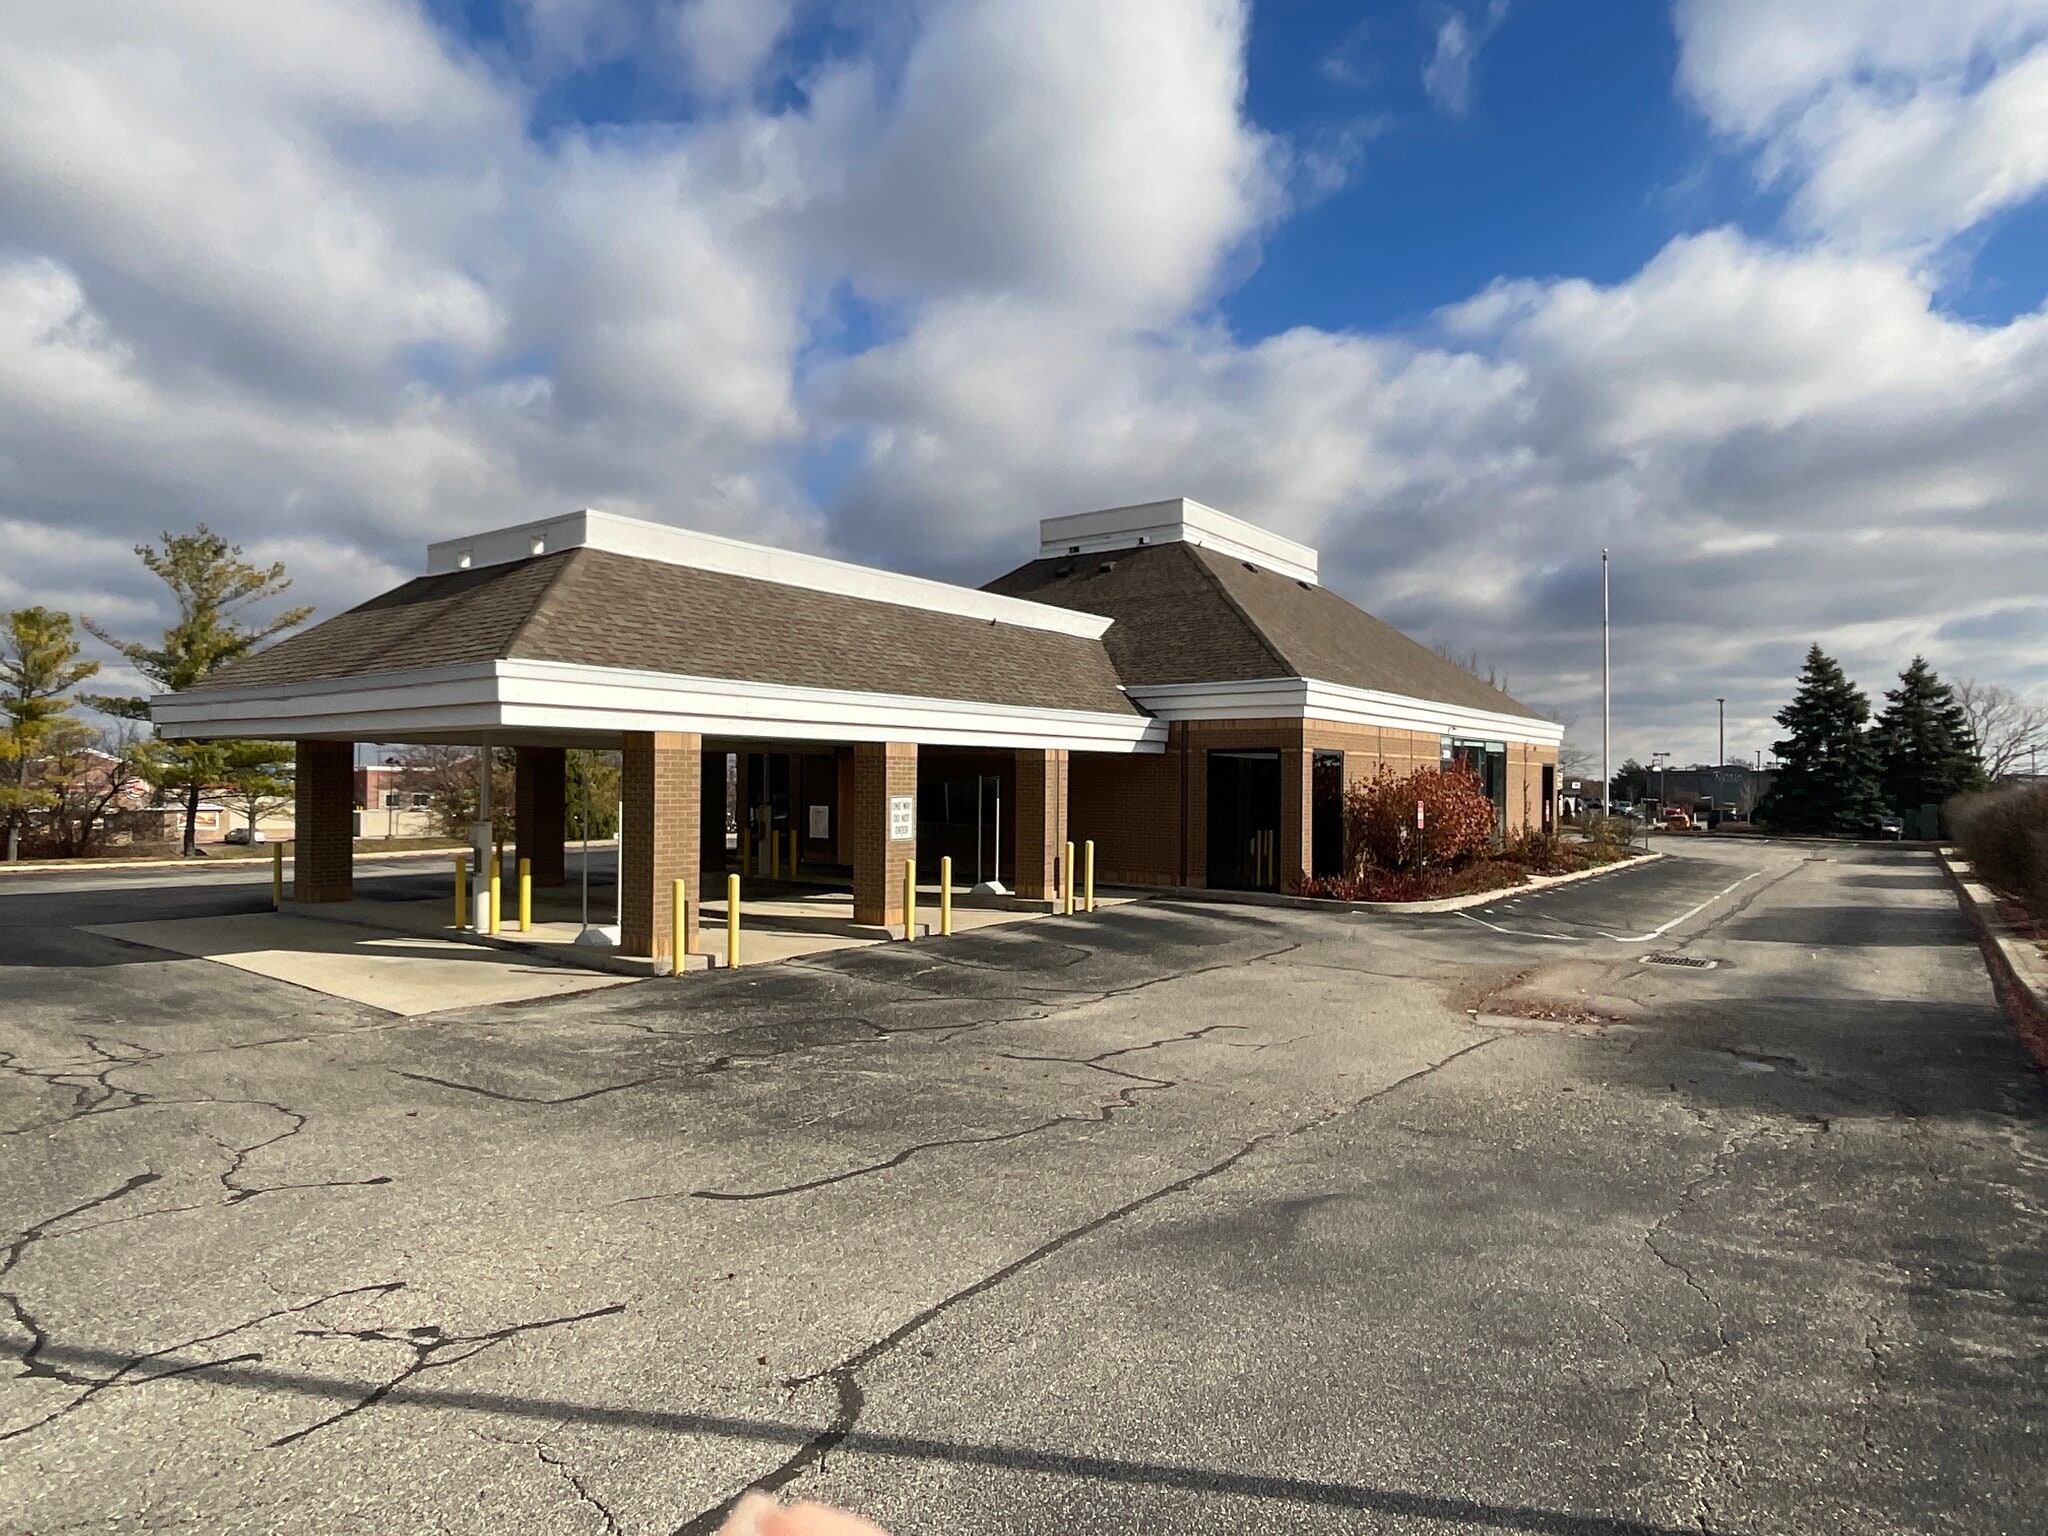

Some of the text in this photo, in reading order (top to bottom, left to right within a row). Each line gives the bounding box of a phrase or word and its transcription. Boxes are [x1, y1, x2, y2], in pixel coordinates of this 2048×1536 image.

[892, 802, 901, 810] ONE
[893, 814, 910, 823] DO NOT
[895, 826, 908, 835] ENTER
